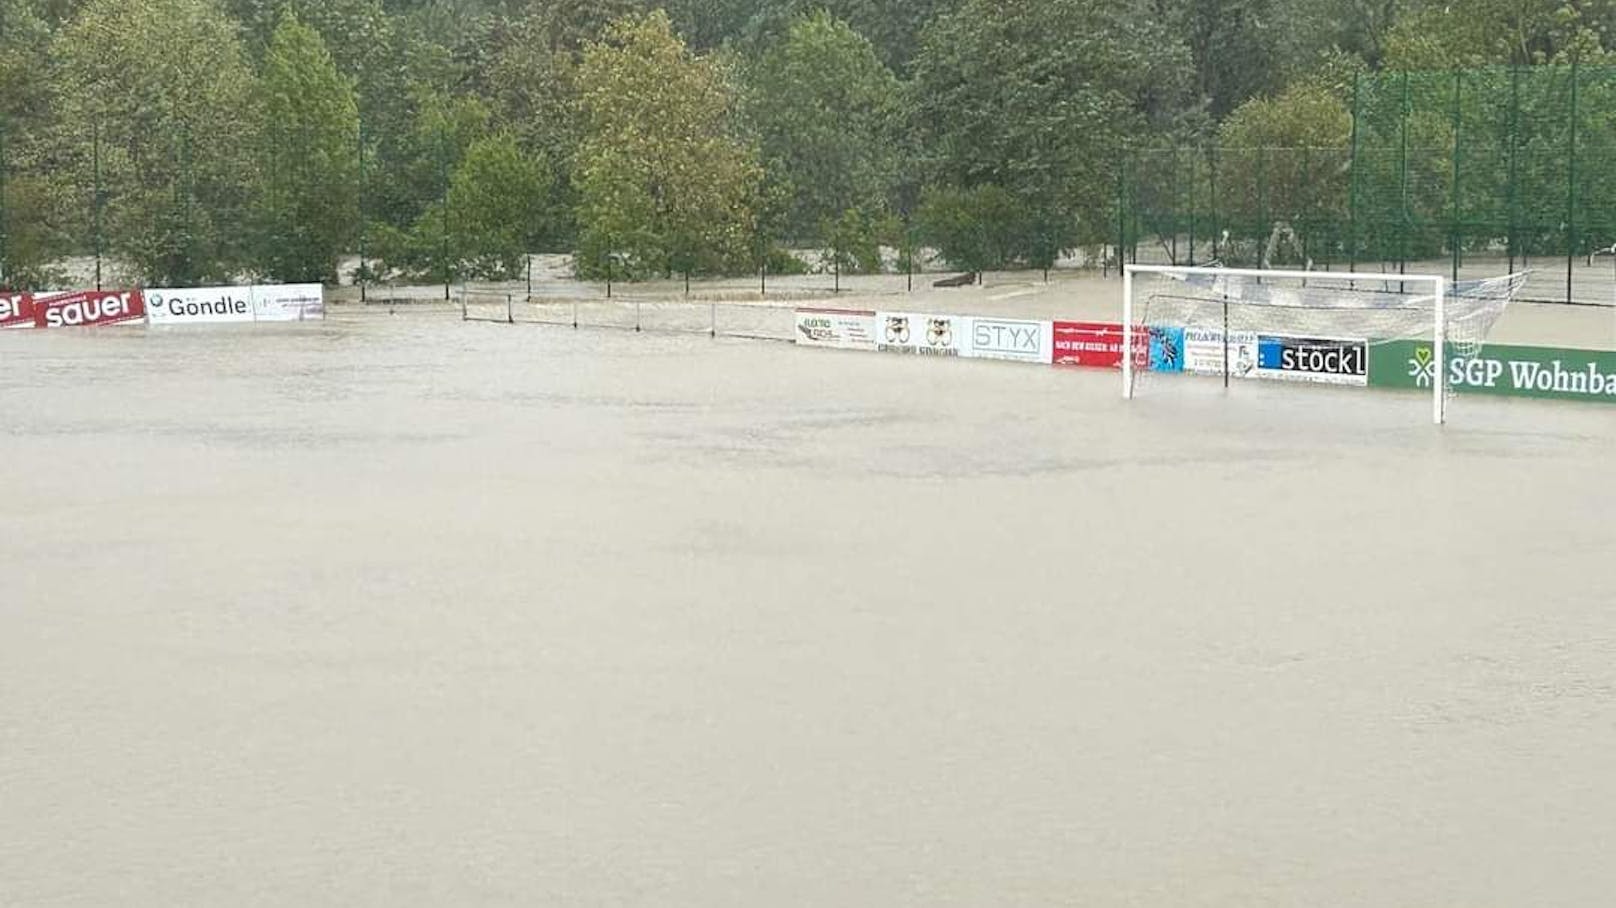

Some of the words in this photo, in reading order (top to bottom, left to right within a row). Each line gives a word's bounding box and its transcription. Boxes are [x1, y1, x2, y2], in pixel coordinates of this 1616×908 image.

[45, 292, 132, 328] sauer
[168, 296, 247, 316] Göndle
[975, 325, 1037, 350] STYX
[1449, 357, 1503, 387] SGP
[1508, 360, 1616, 394] Wohnba
